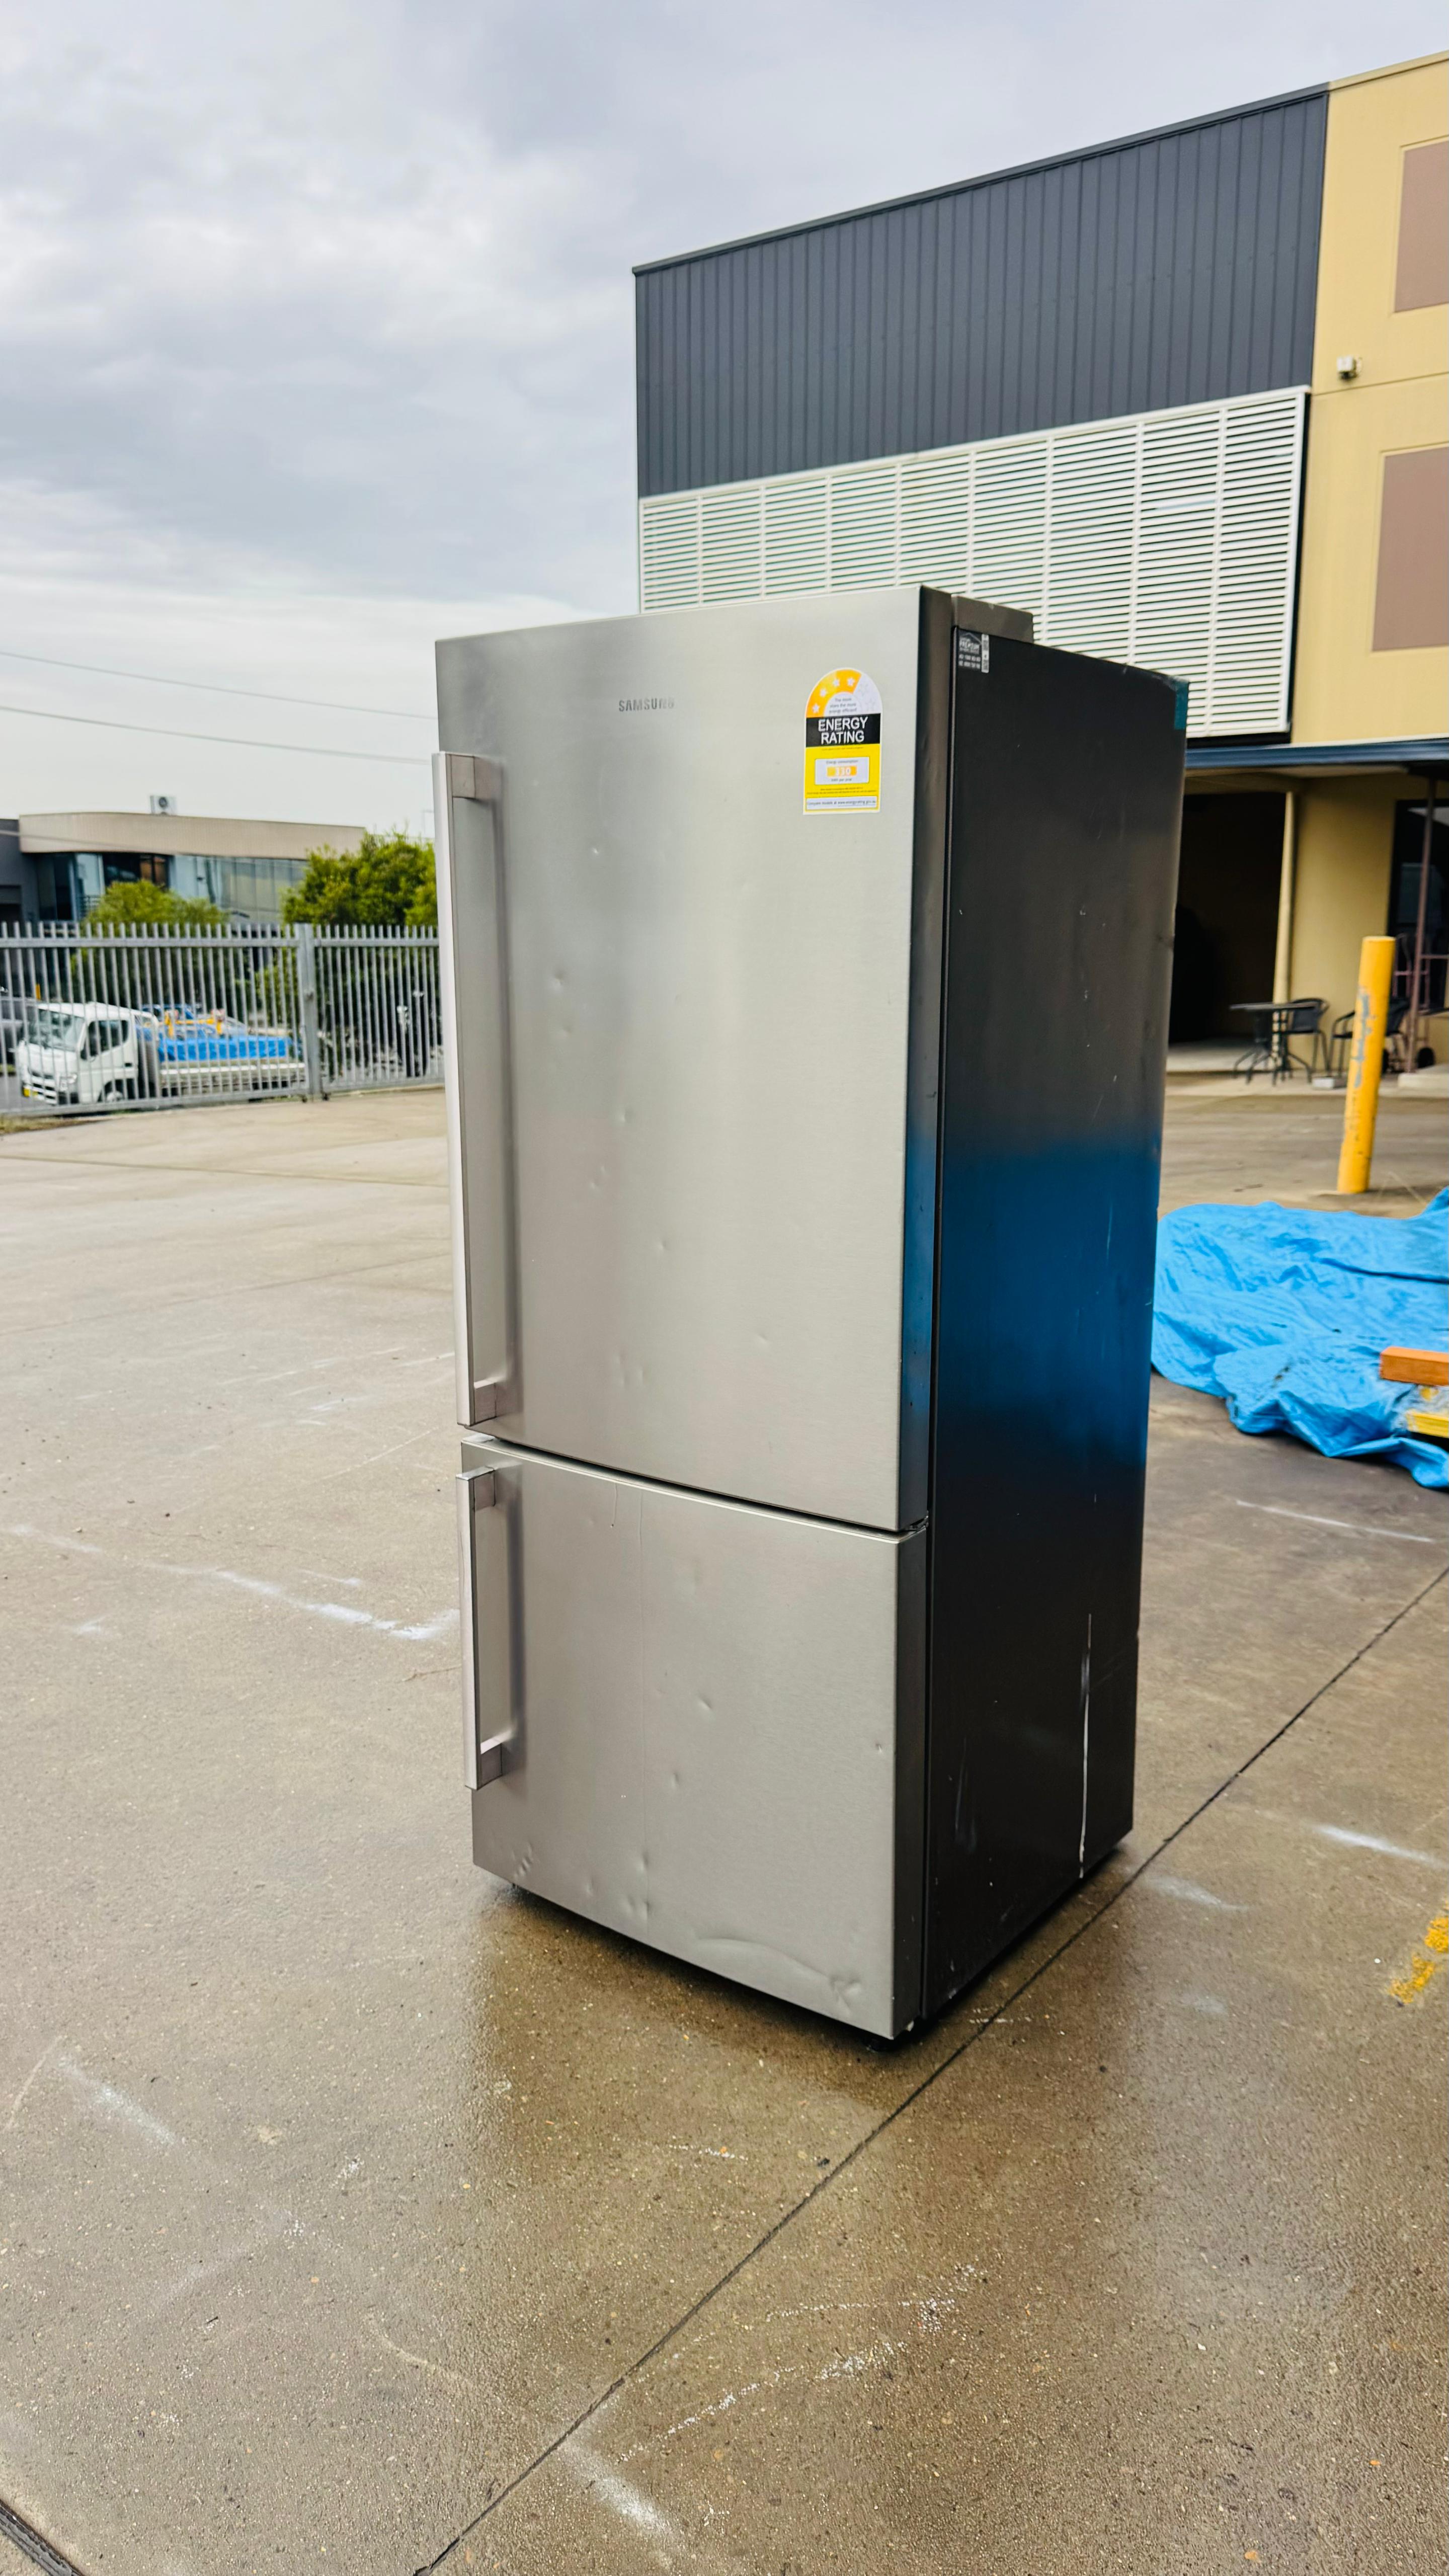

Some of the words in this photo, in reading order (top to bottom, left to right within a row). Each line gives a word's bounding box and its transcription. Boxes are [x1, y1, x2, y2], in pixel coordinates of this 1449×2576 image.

[619, 697, 675, 712] SAMSUNG
[818, 716, 868, 732] ENERGY
[821, 730, 864, 745] RATING
